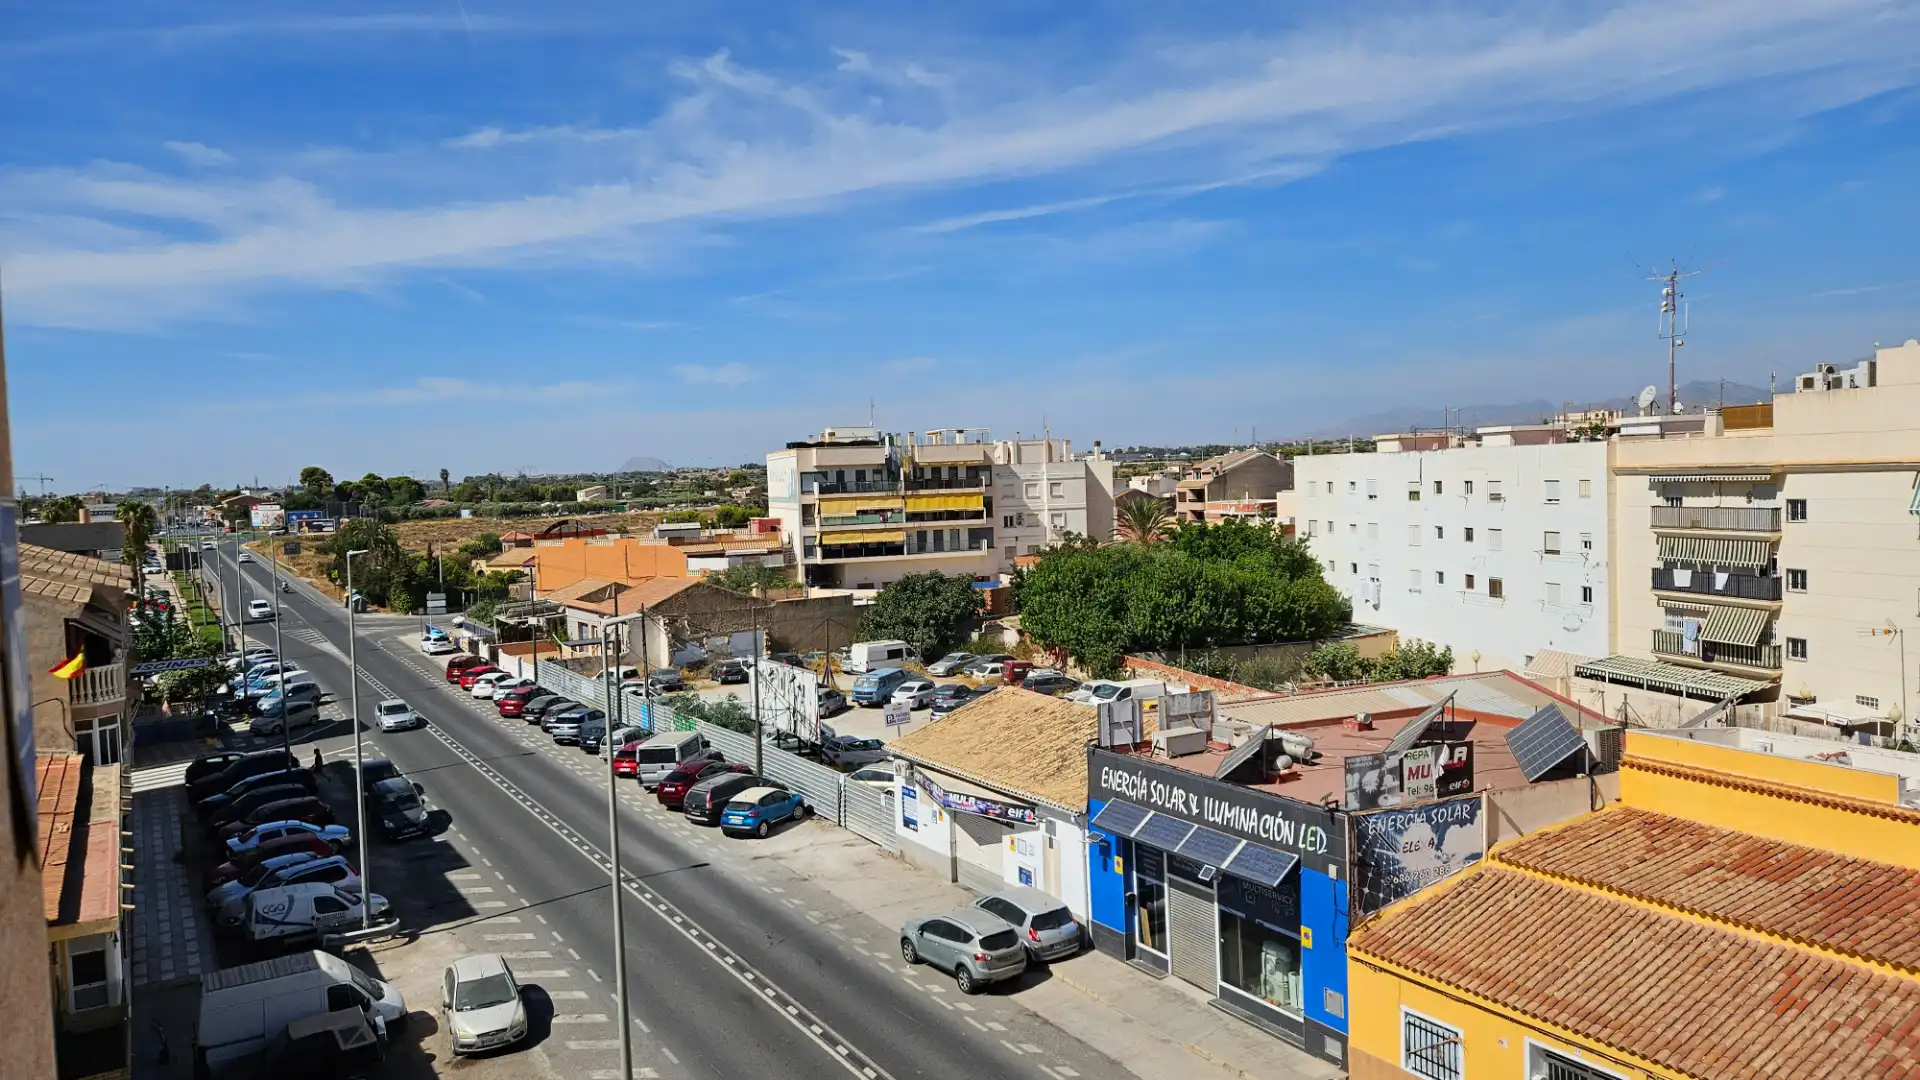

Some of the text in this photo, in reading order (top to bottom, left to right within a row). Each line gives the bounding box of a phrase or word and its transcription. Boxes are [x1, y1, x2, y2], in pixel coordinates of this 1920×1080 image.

[135, 659, 206, 670] ISCINAS
[1406, 750, 1430, 761] REPA
[1407, 764, 1432, 780] MU
[1423, 783, 1435, 793] 96
[1007, 808, 1024, 818] elf
[1101, 766, 1148, 801] ENERGÍA
[1150, 780, 1187, 814] SOLAR
[1204, 797, 1295, 846] ILUMINACIÓN
[1299, 823, 1328, 855] LED
[1431, 804, 1471, 825] SOLAR
